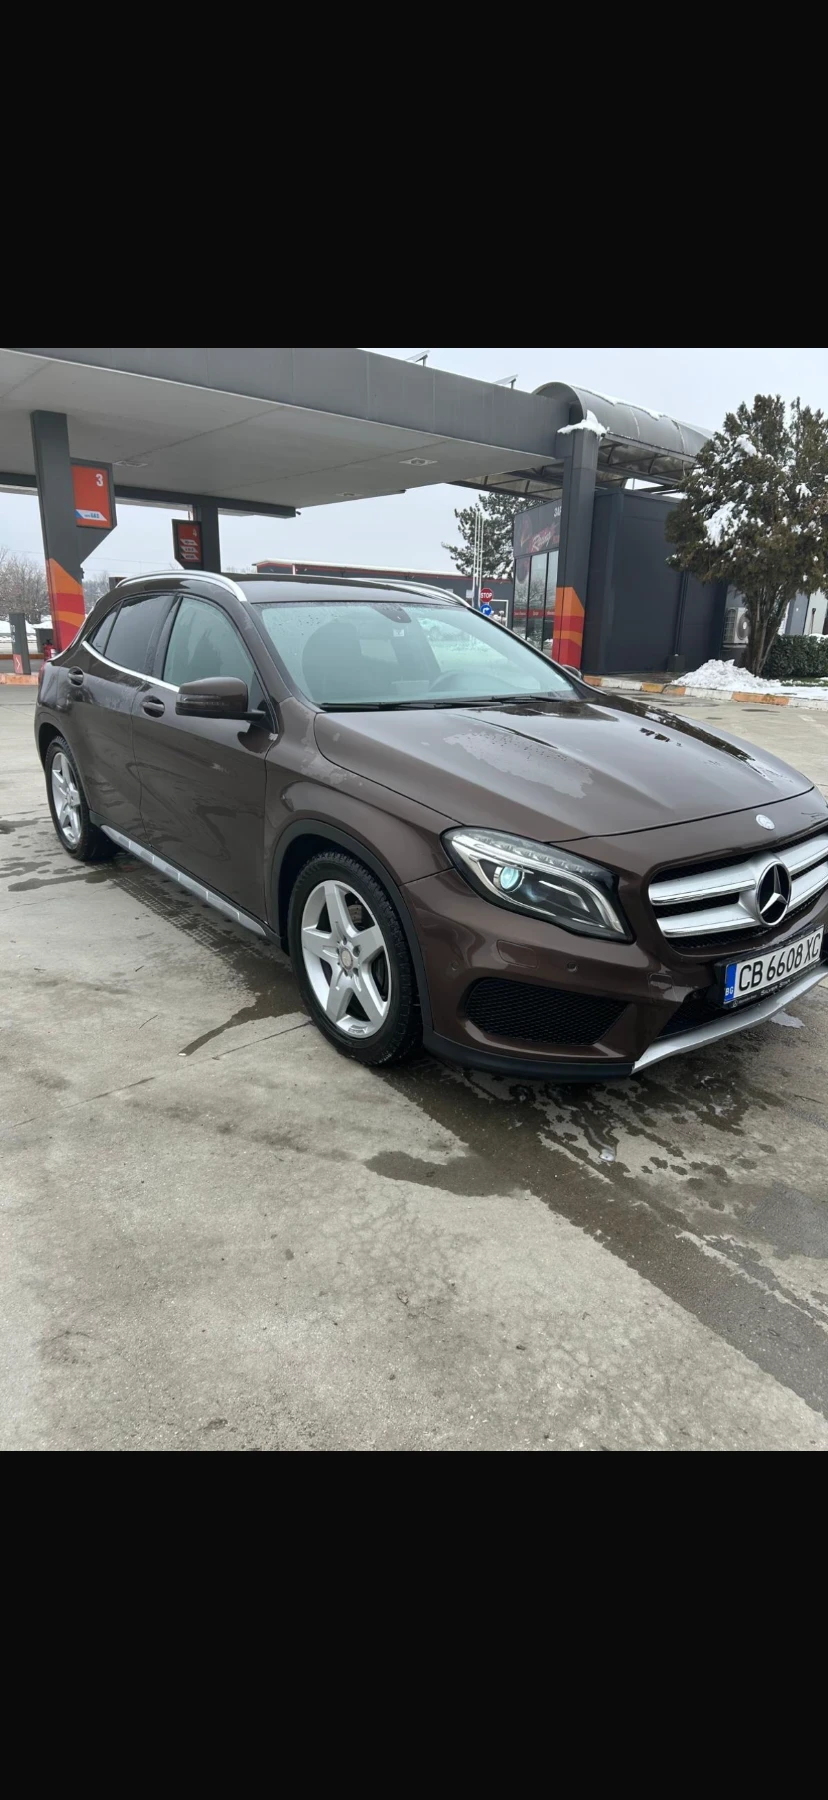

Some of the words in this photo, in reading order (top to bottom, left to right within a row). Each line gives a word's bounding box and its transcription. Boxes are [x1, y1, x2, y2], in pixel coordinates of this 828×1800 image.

[96, 473, 103, 487] 3
[739, 960, 764, 992] CB
[766, 943, 804, 982] 6608
[804, 933, 821, 964] XC
[725, 986, 734, 996] BG
